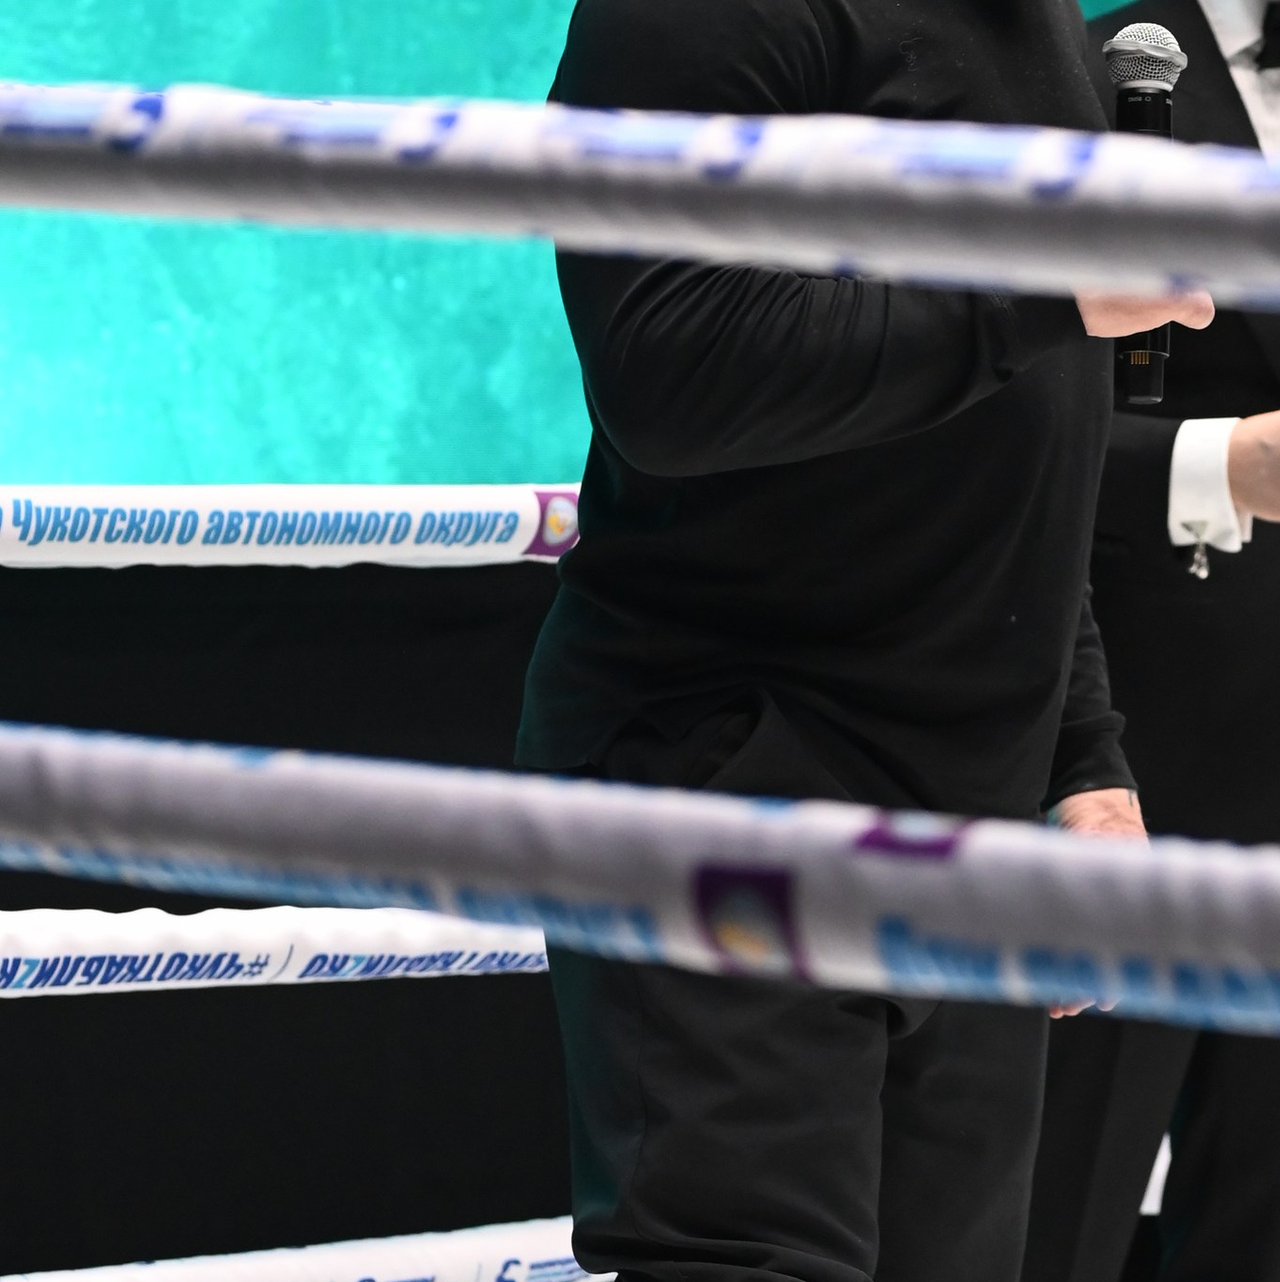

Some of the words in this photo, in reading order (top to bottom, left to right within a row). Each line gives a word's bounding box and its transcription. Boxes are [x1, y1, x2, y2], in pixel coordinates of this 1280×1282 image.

[11, 498, 197, 546] Чукотского
[201, 509, 411, 546] автономного
[414, 510, 520, 546] округа
